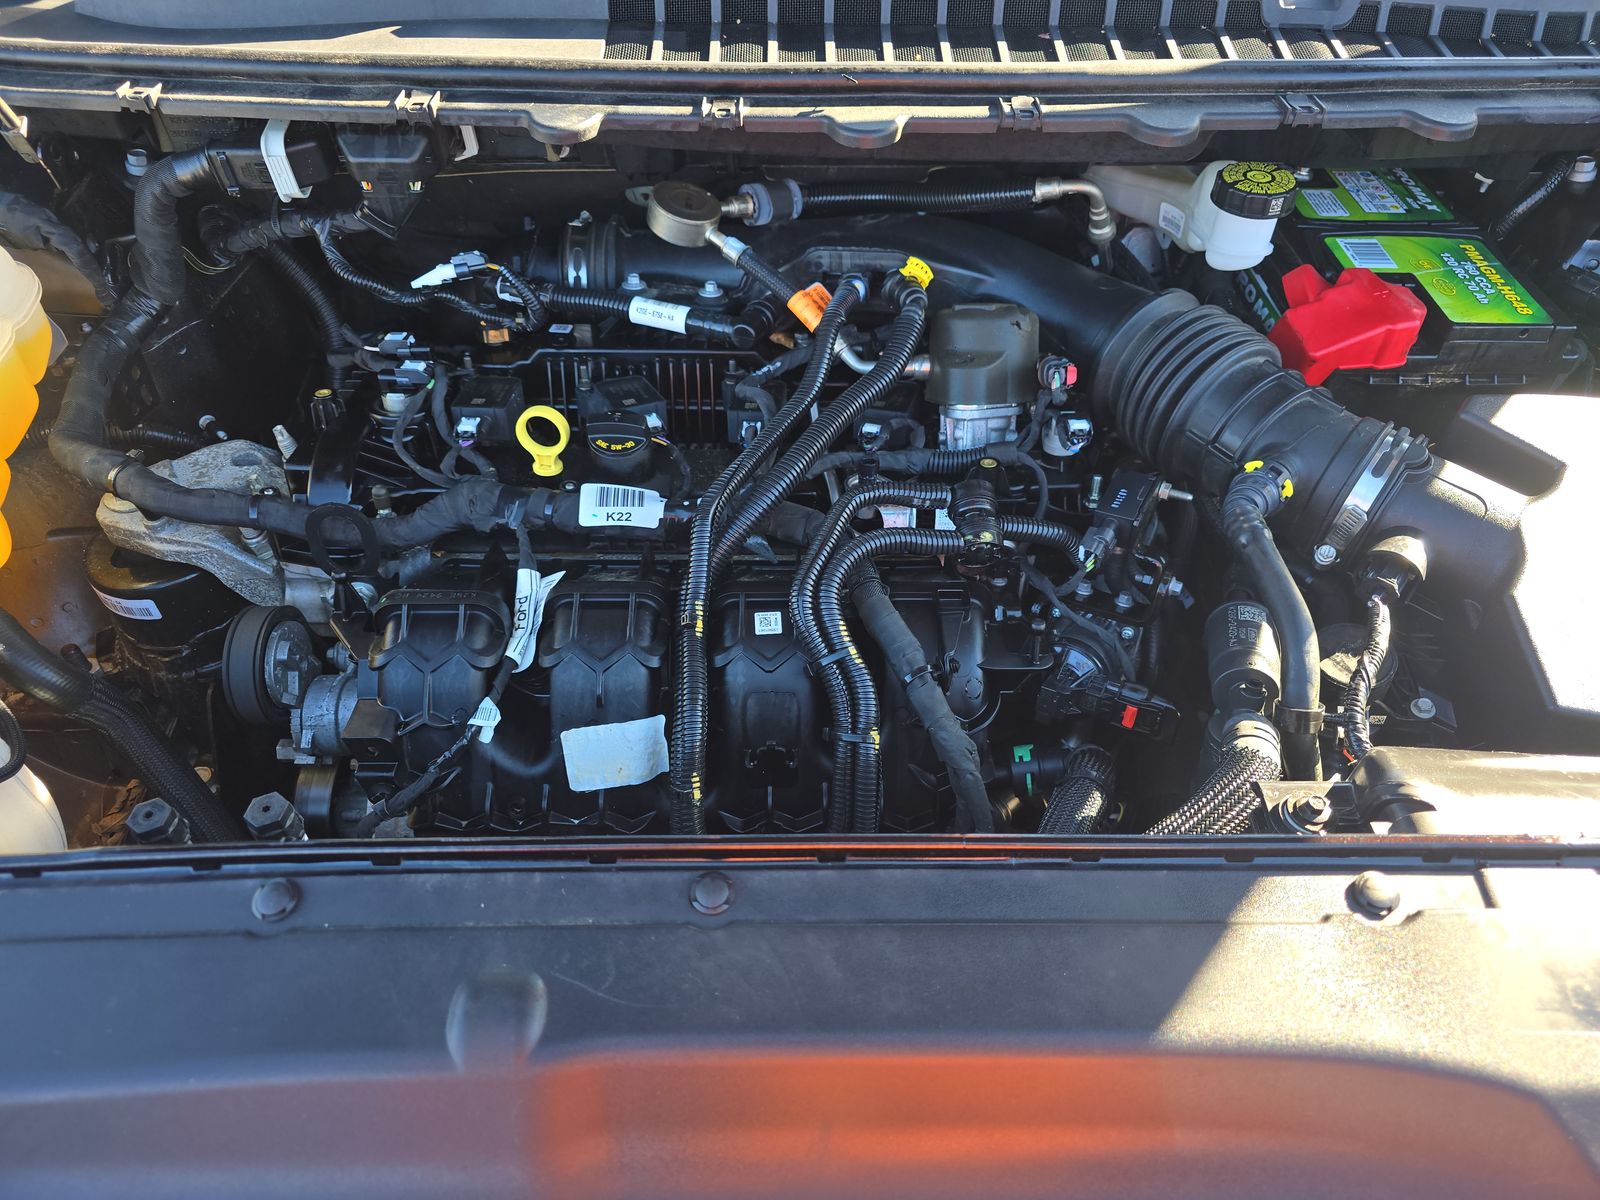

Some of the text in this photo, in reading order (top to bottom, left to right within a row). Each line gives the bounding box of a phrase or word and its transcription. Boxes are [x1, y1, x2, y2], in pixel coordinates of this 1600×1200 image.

[1441, 252, 1459, 267] 120
[1452, 267, 1470, 279] RC
[1464, 281, 1480, 291] 70
[1473, 292, 1489, 304] Ah
[1459, 244, 1533, 315] PMAGM-H648
[1461, 261, 1496, 295] 760 CCA
[595, 439, 635, 450] SAE 5W-30
[606, 511, 632, 521] K22
[514, 595, 528, 631] Ford
